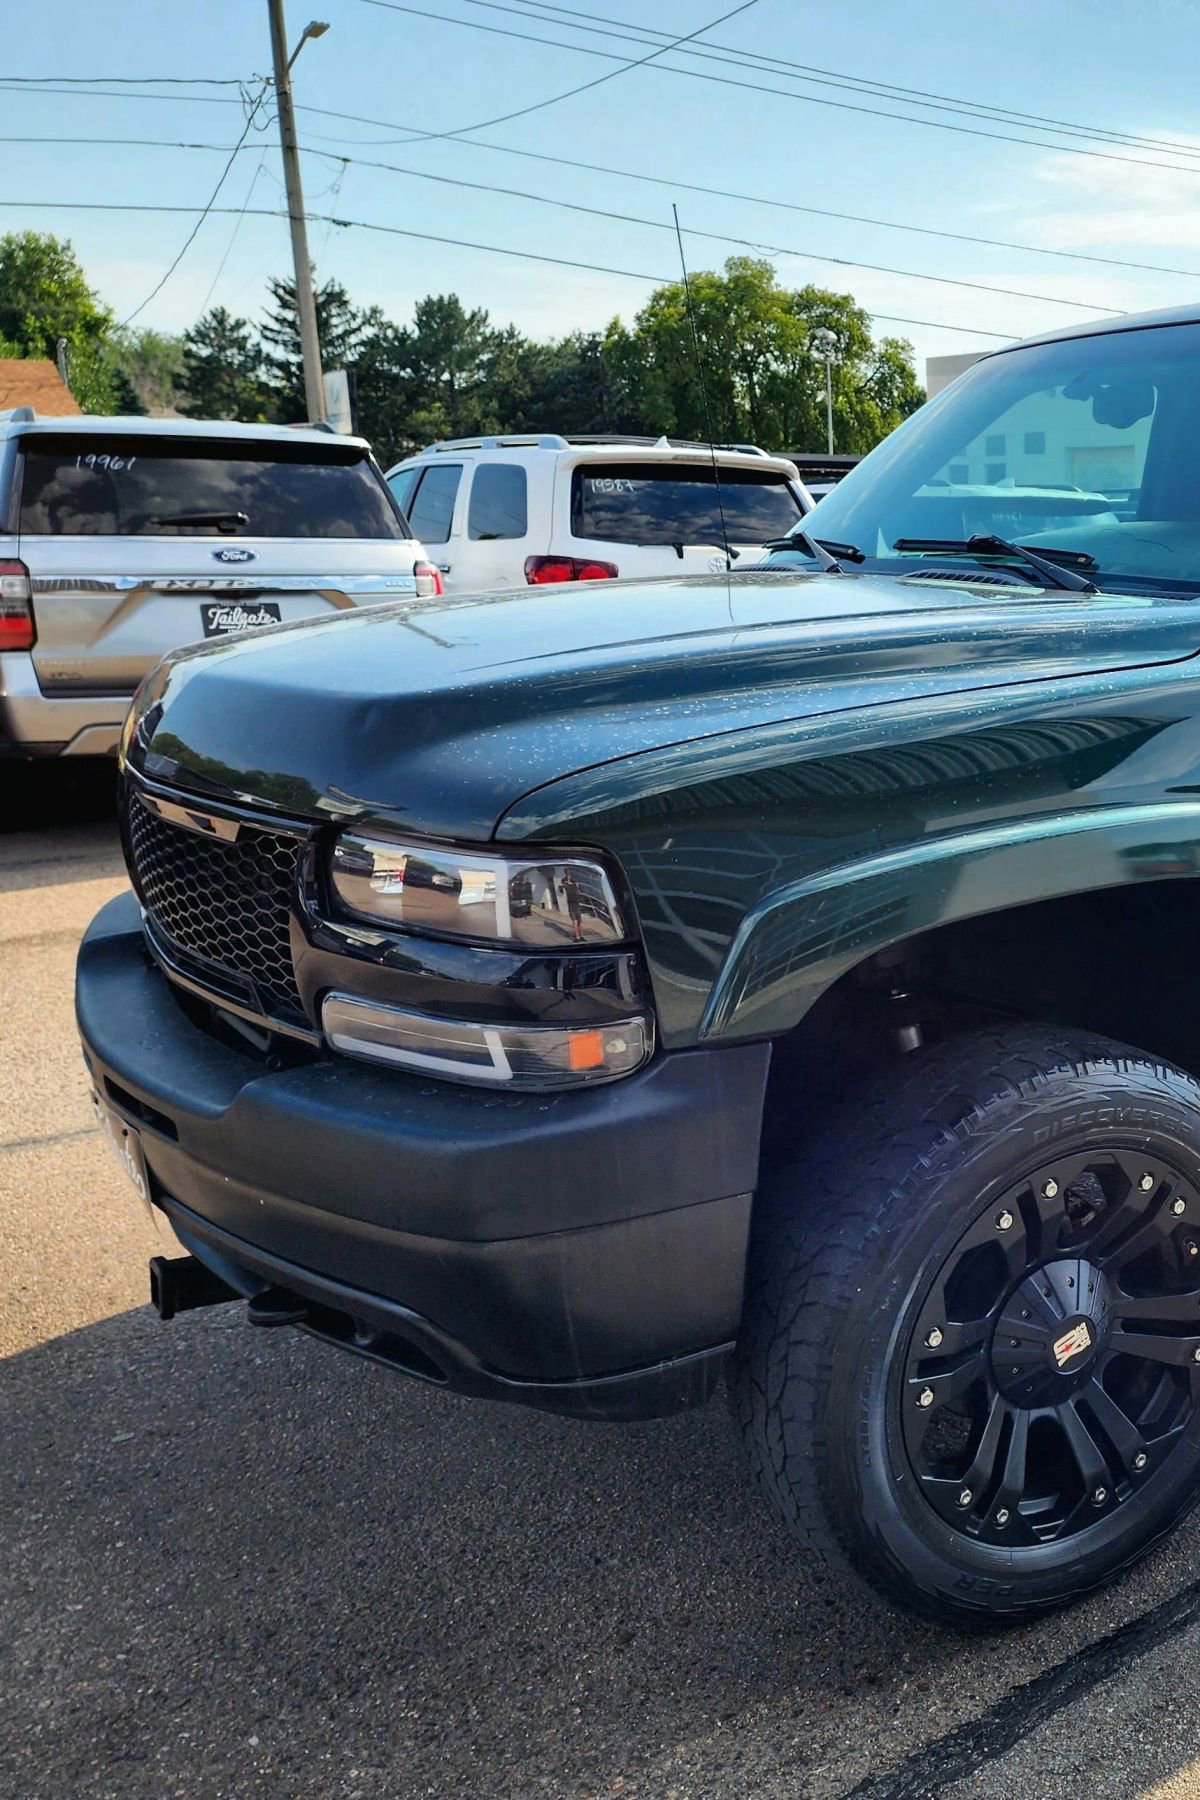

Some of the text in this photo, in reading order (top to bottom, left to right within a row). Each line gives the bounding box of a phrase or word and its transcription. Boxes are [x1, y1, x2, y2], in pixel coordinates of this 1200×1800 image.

[76, 454, 136, 471] 19961
[221, 550, 249, 561] Ford
[208, 607, 277, 630] Tailgate
